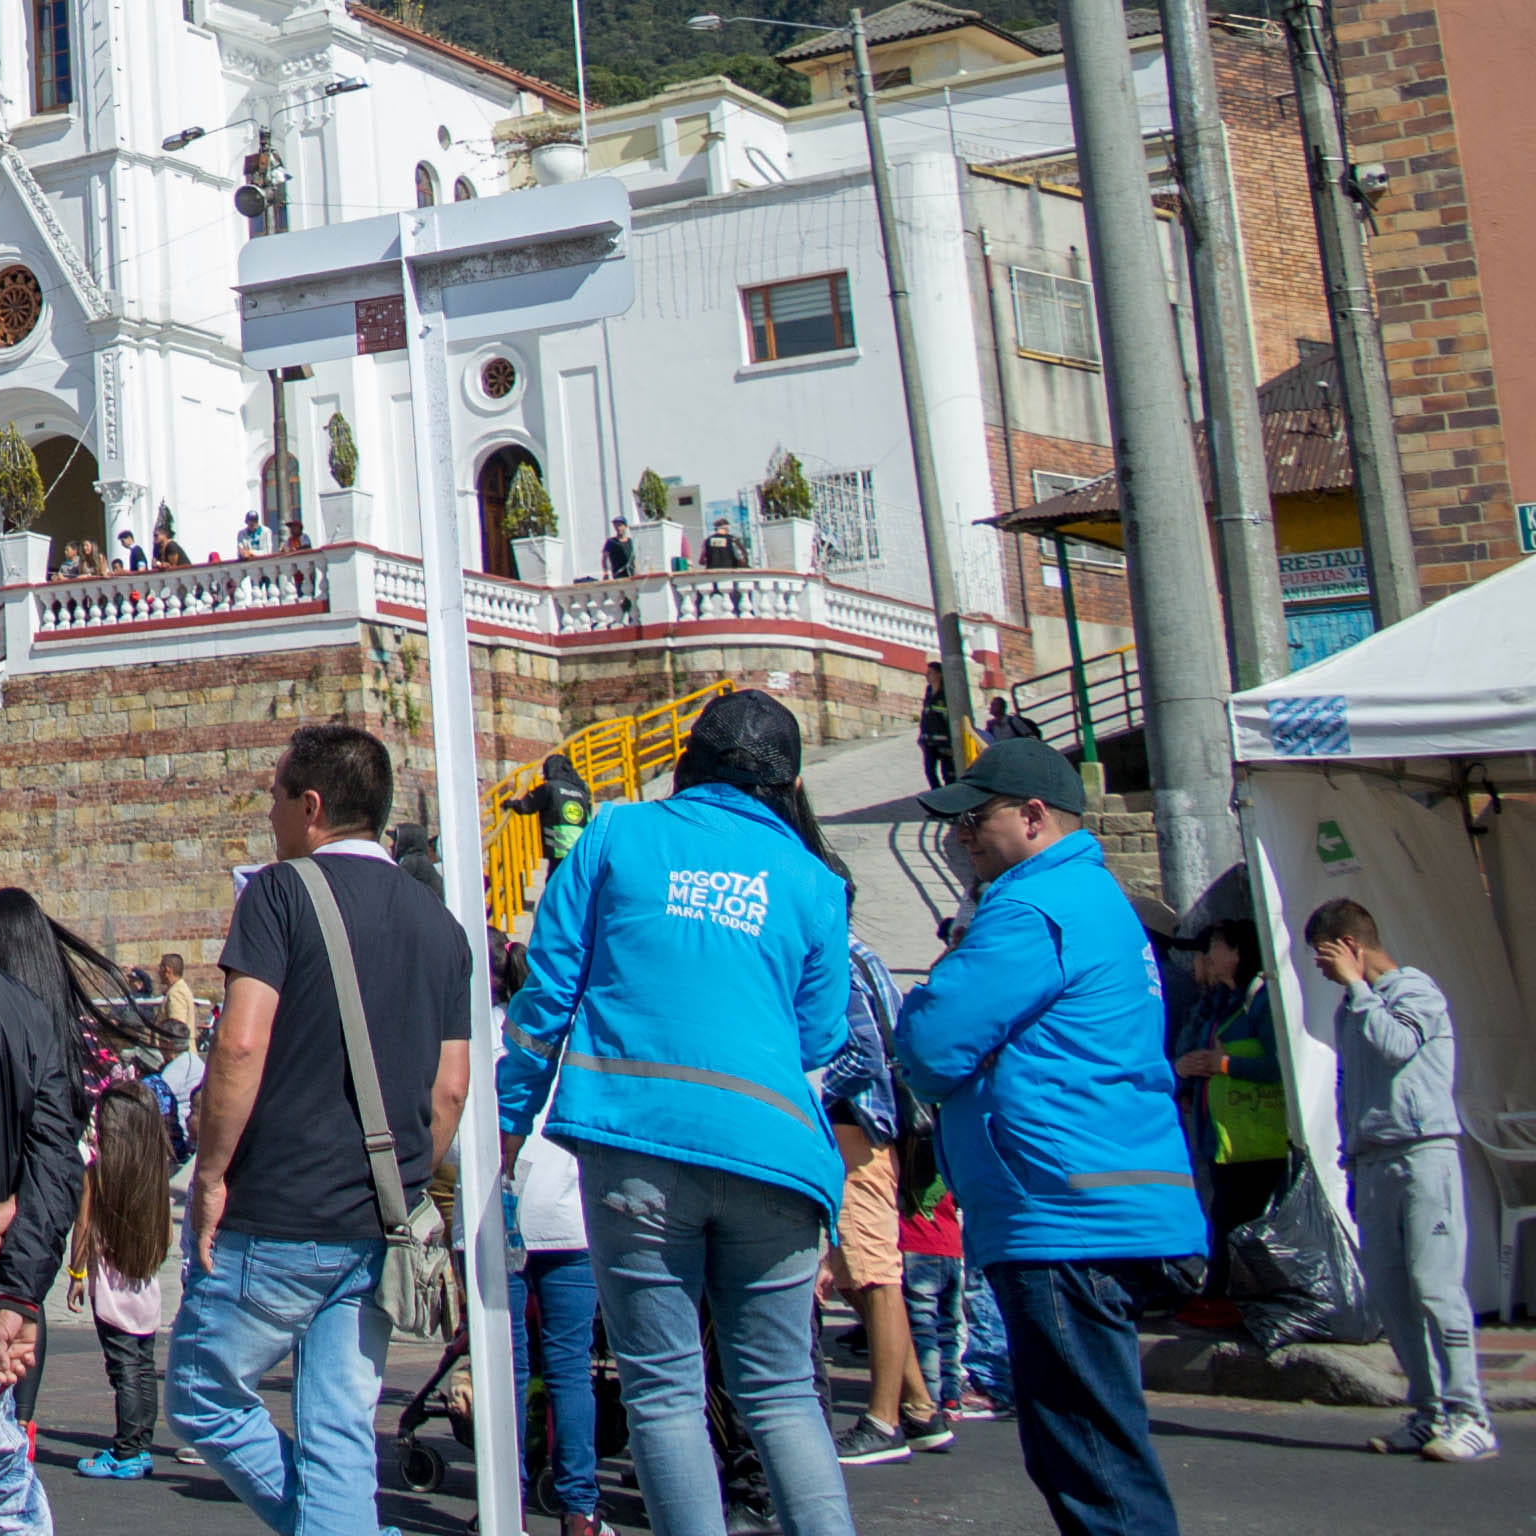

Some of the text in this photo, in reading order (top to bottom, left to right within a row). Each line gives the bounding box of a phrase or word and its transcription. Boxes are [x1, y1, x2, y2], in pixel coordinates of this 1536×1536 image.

[668, 883, 767, 925] MEJOR
[669, 870, 769, 905] BOGOTÁ
[666, 904, 761, 937] PARA TODOS
